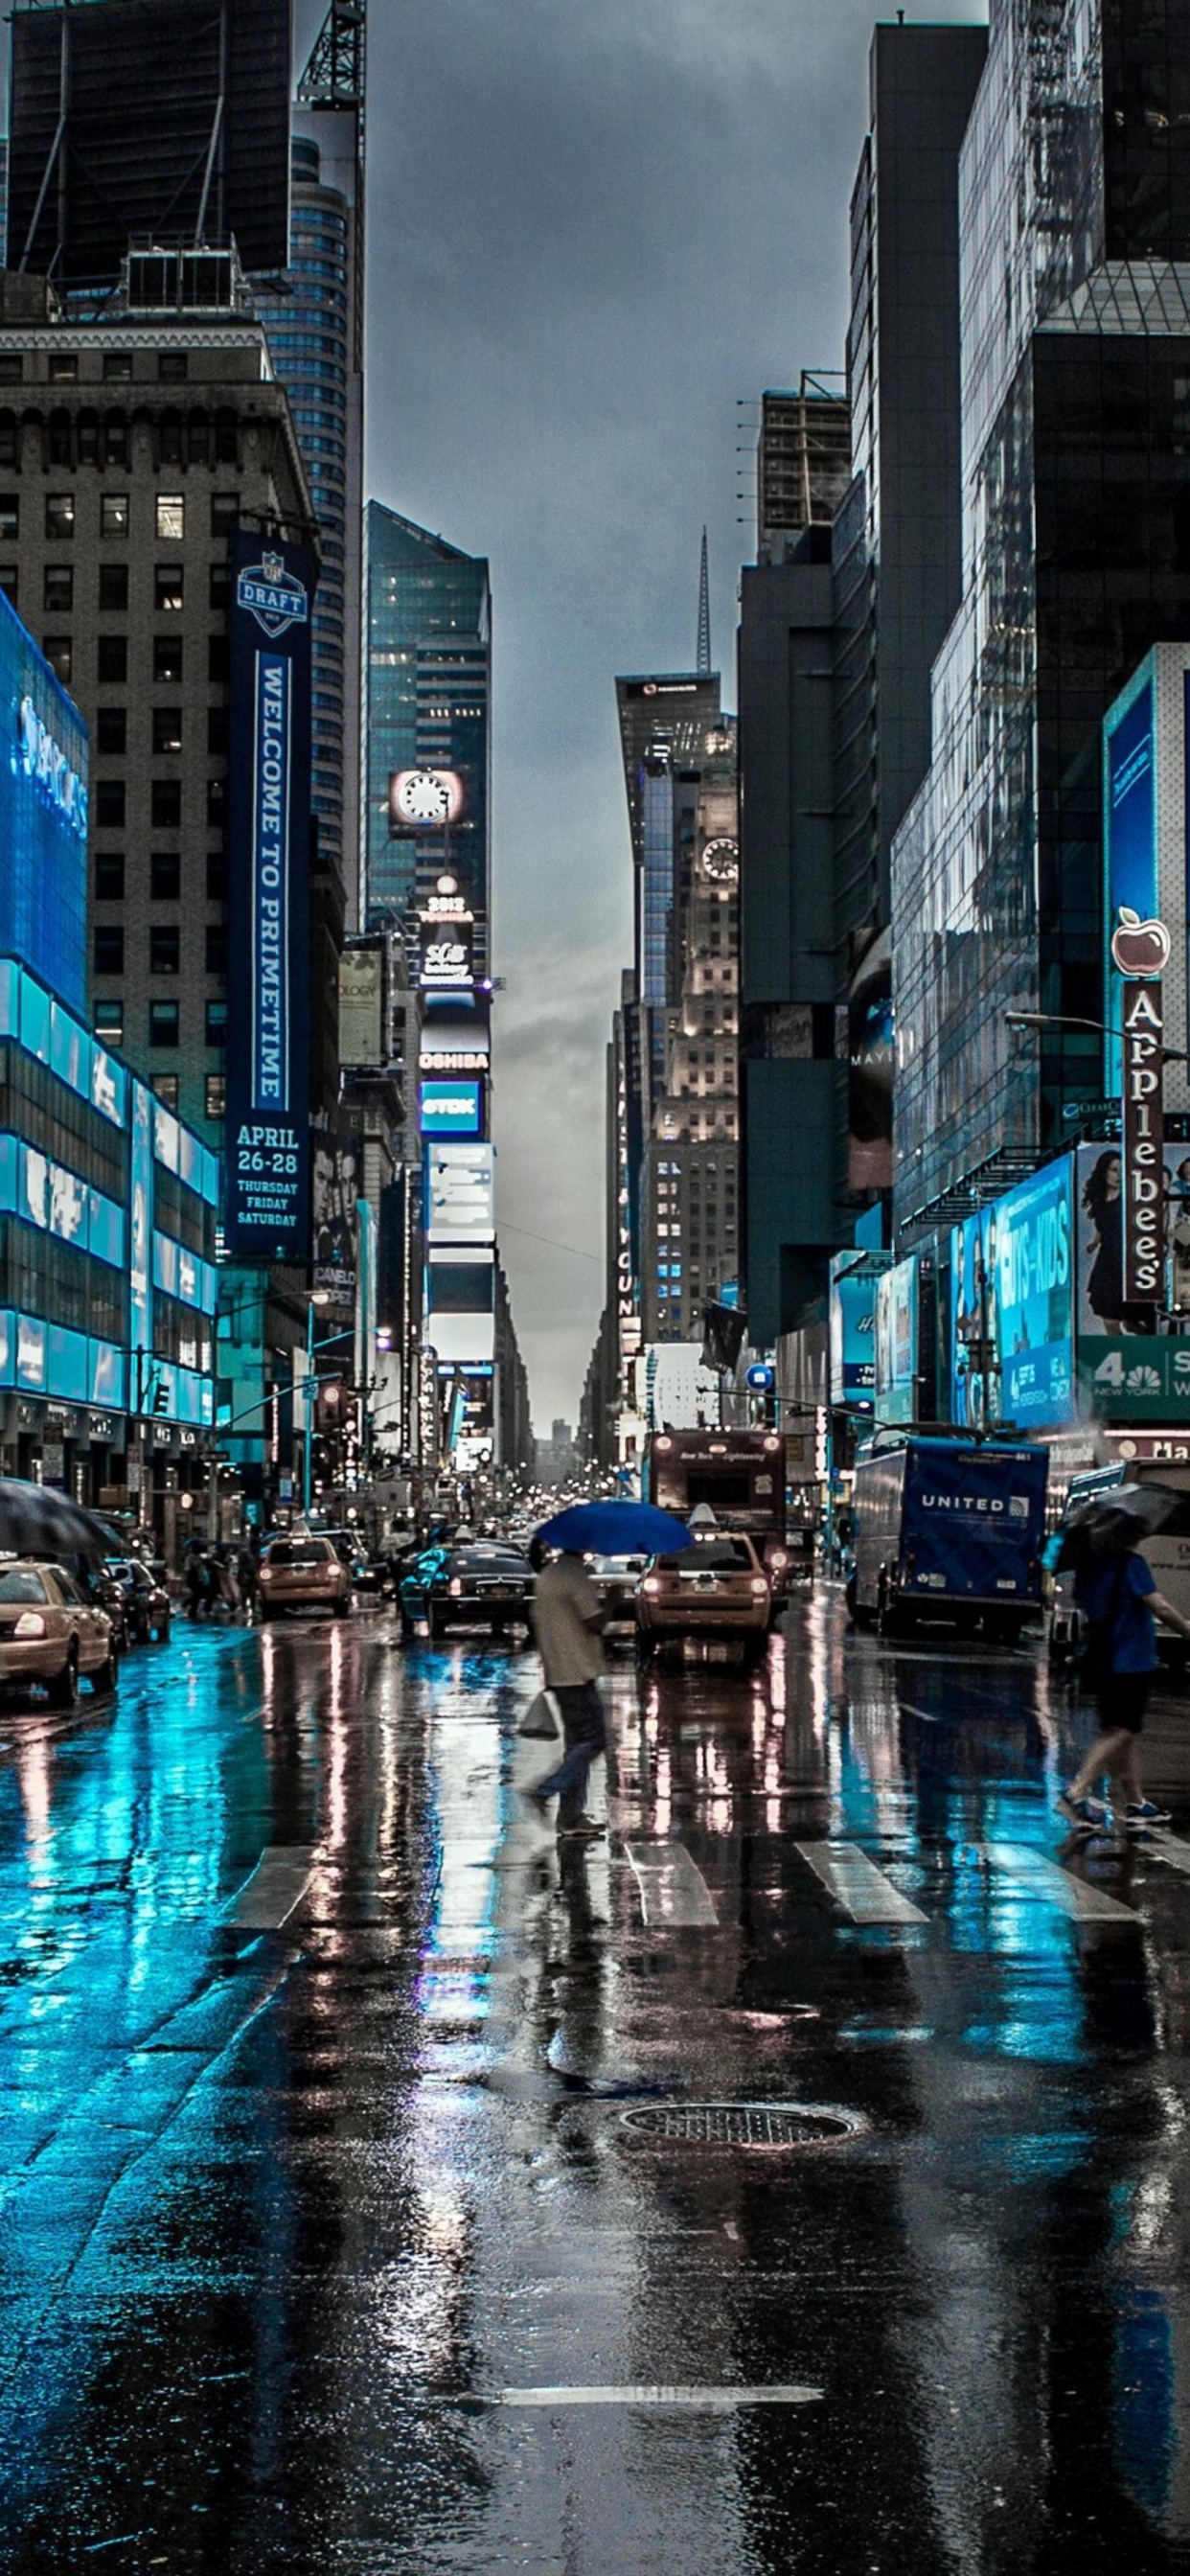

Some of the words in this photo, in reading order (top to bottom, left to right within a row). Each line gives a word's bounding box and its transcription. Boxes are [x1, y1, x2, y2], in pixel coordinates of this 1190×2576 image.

[244, 586, 301, 611] DRAFT
[262, 666, 283, 834] WELCOME
[261, 843, 280, 886] TO
[261, 896, 280, 1098] PRIMETIME
[237, 1124, 299, 1149] APRIL
[1125, 990, 1162, 1290] Applebee's
[238, 1150, 297, 1174] 26-28
[237, 1180, 298, 1195] THURSDAY
[247, 1196, 288, 1209] FRIDAY
[238, 1211, 297, 1226] SATURDAY
[1036, 1200, 1069, 1294] KIDS
[1094, 1351, 1125, 1388] 4
[1094, 1388, 1122, 1396] NEW
[1126, 1387, 1160, 1397] YORK
[922, 1494, 1004, 1511] UNITED
